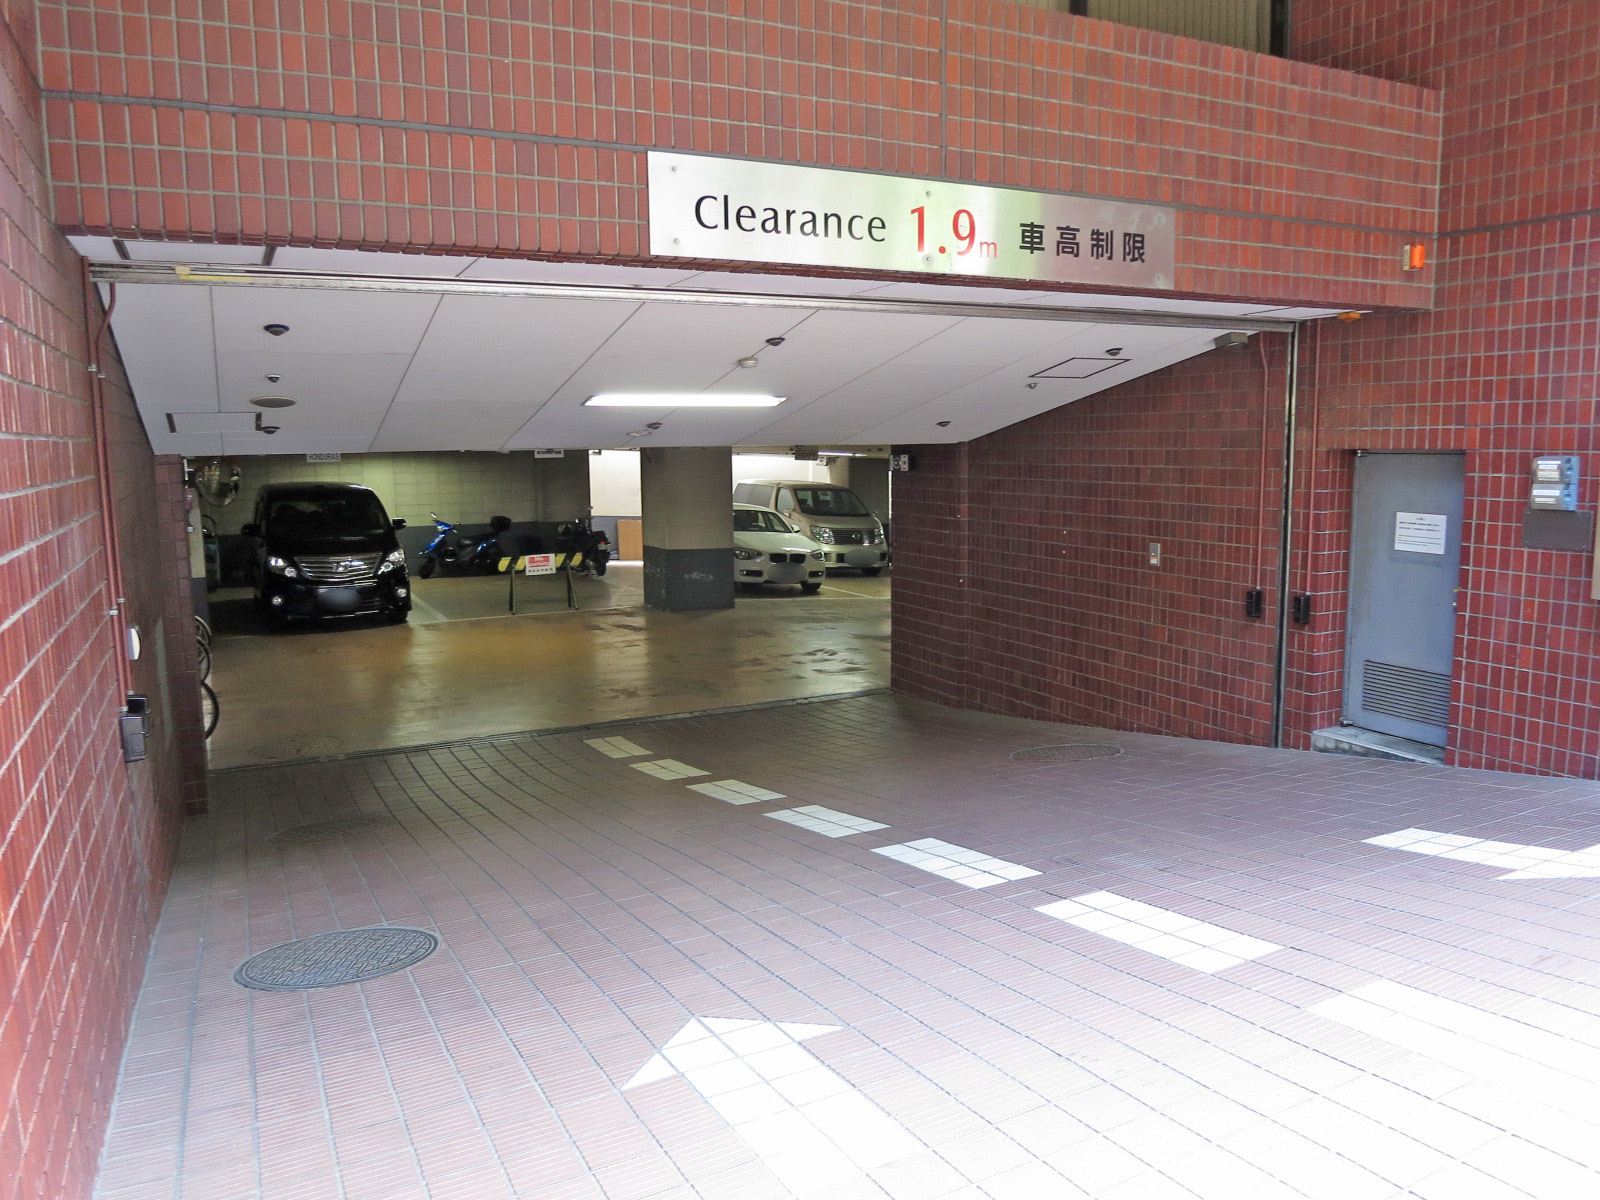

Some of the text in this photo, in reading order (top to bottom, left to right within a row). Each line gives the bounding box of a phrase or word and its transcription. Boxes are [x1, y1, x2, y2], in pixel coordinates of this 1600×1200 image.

[694, 194, 887, 242] Clearance
[1019, 221, 1146, 264] 車高制限
[308, 452, 340, 461] HONDURAS
